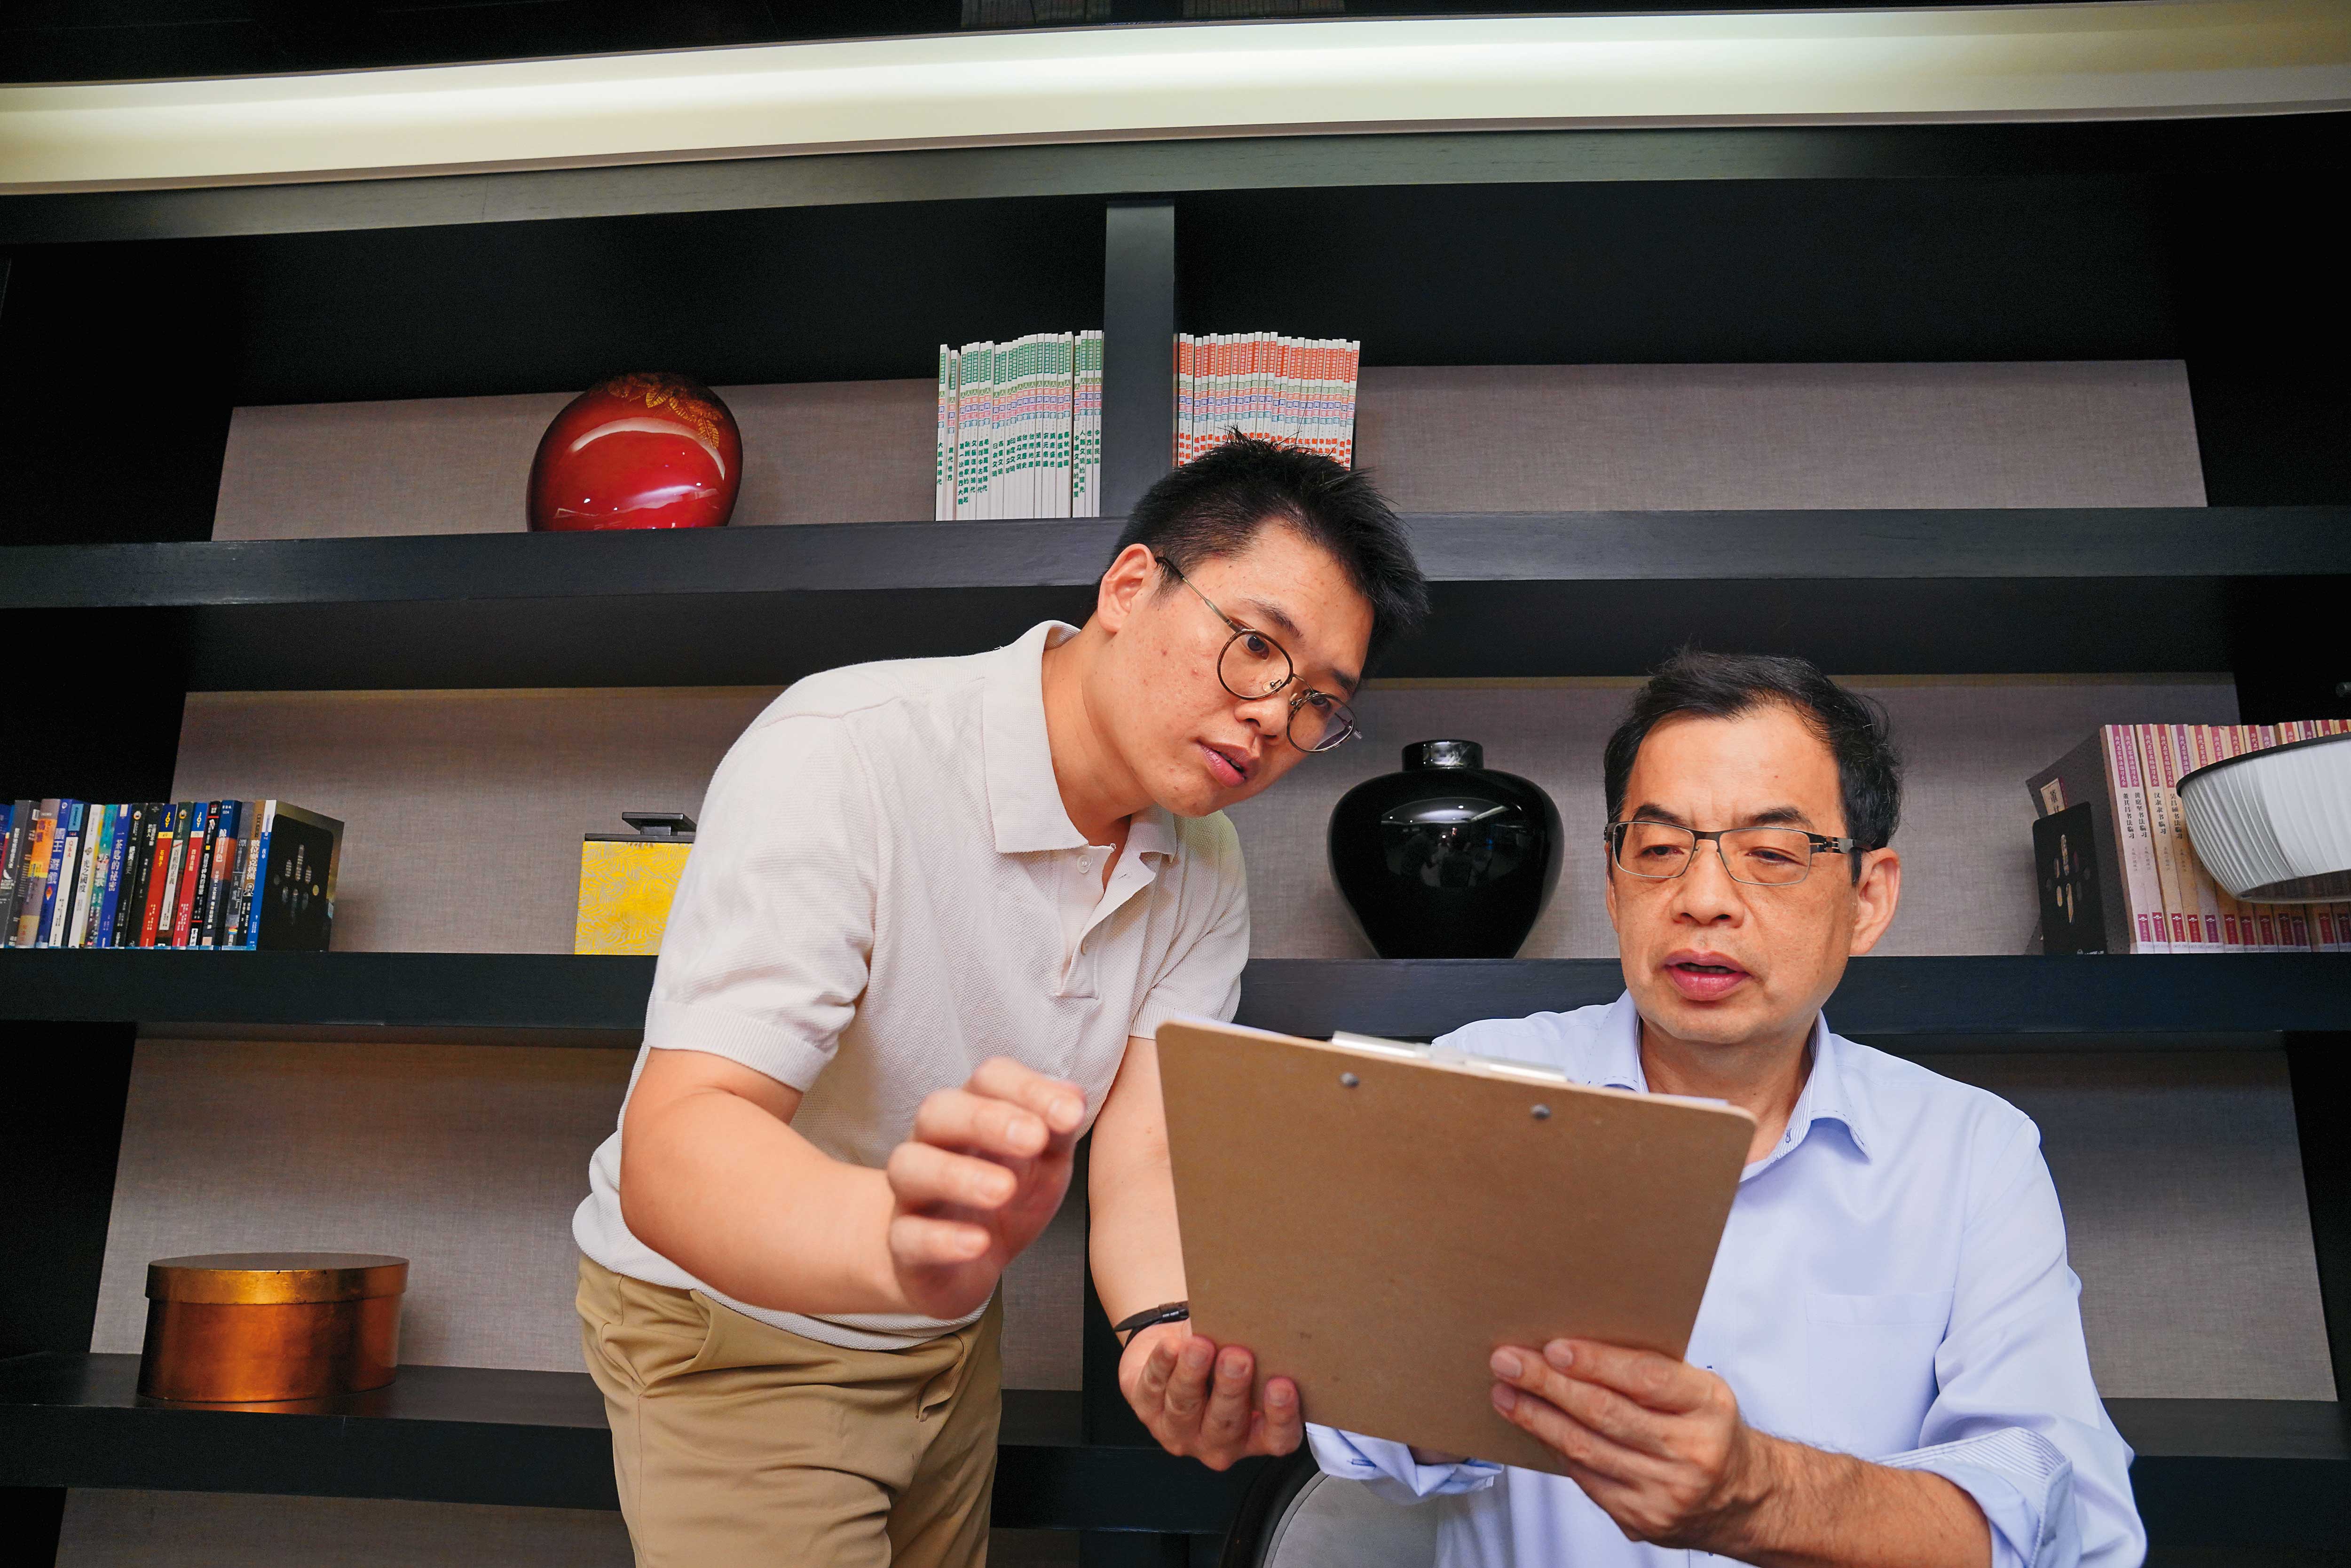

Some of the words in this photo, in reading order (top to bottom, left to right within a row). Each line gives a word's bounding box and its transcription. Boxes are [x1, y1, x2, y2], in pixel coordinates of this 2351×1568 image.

[2123, 793, 2134, 839] 董其昌书法临习
[2135, 792, 2147, 838] 黄庭坚书法临习
